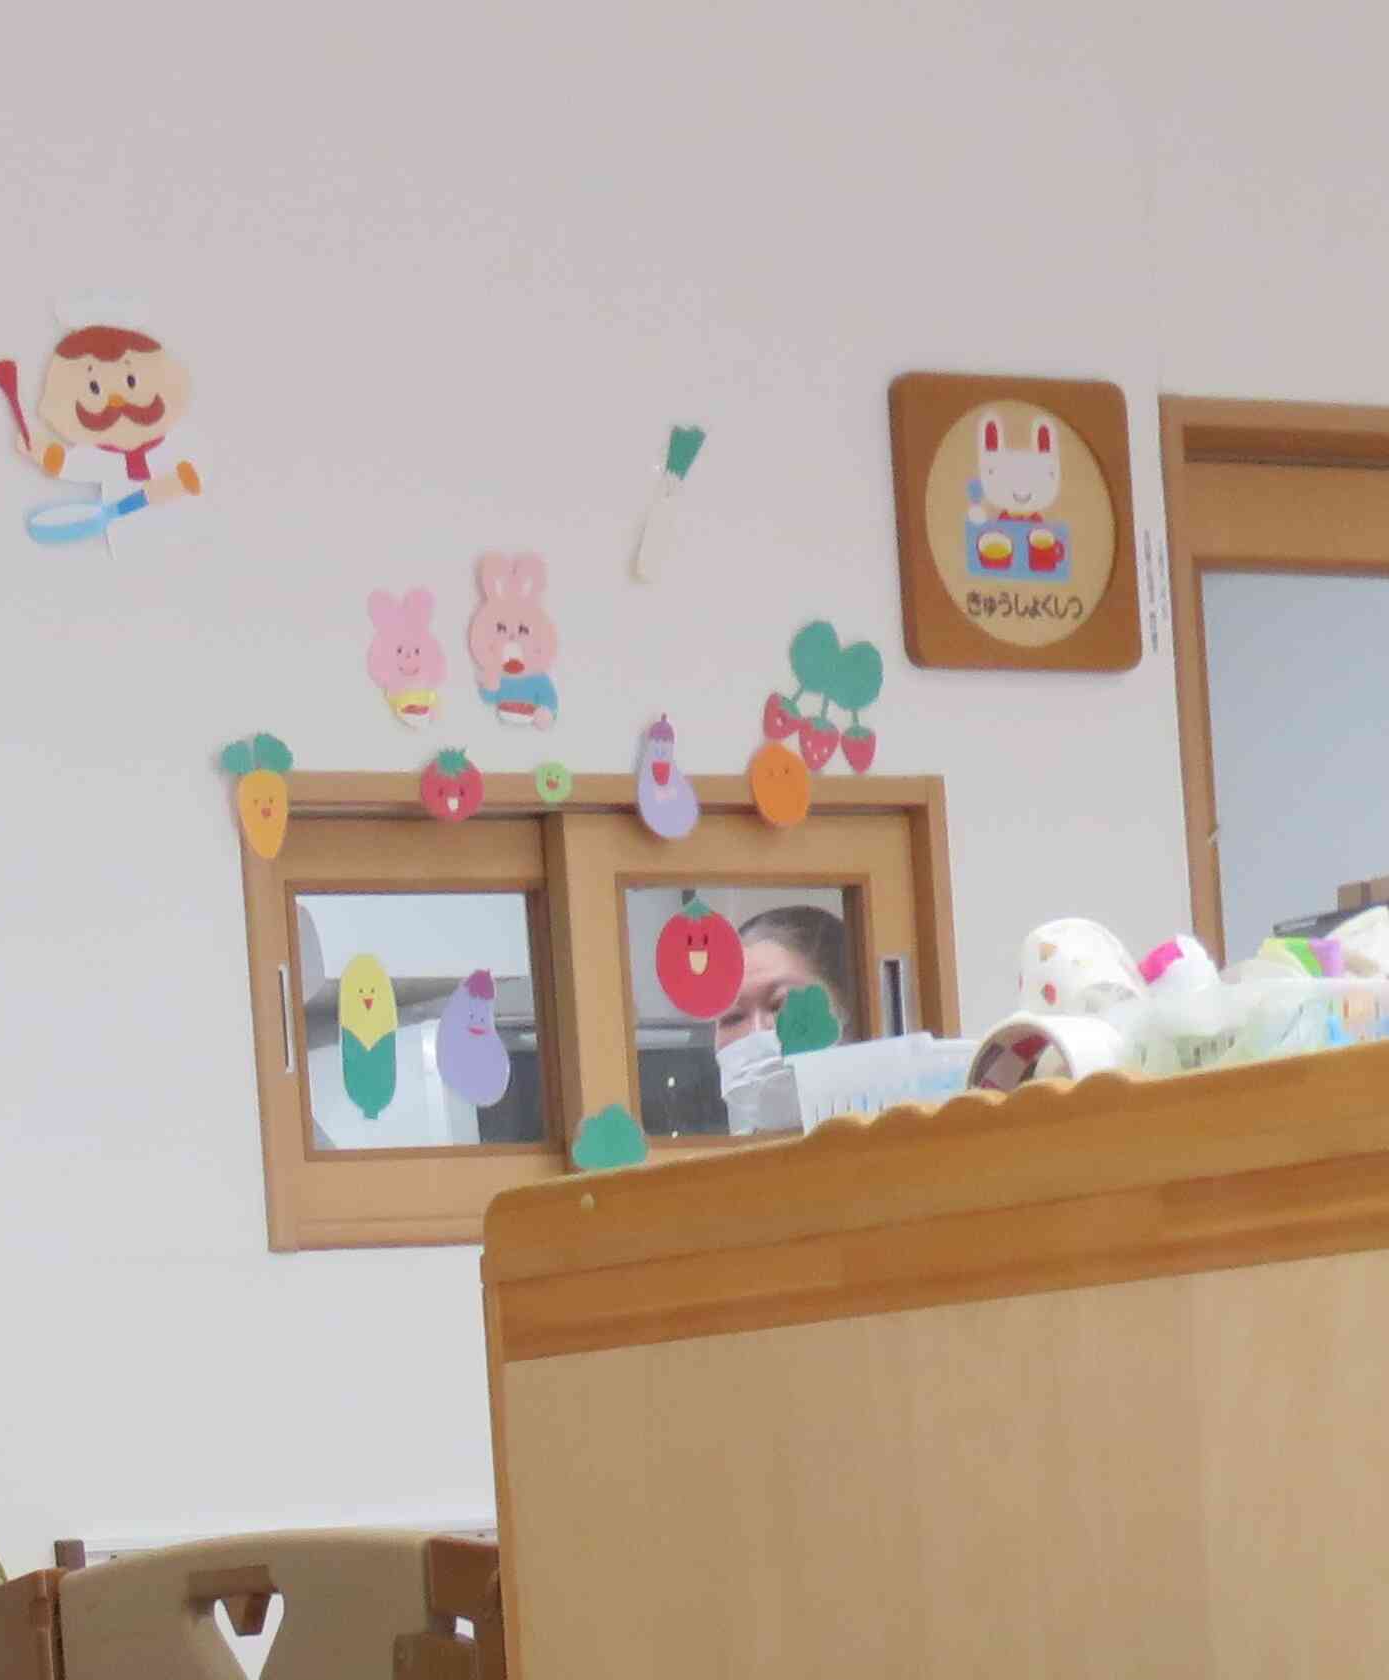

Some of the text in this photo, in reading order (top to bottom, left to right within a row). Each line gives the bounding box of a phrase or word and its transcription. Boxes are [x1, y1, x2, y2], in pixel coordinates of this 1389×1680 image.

[965, 591, 1084, 619] きゅうしょくしつ
